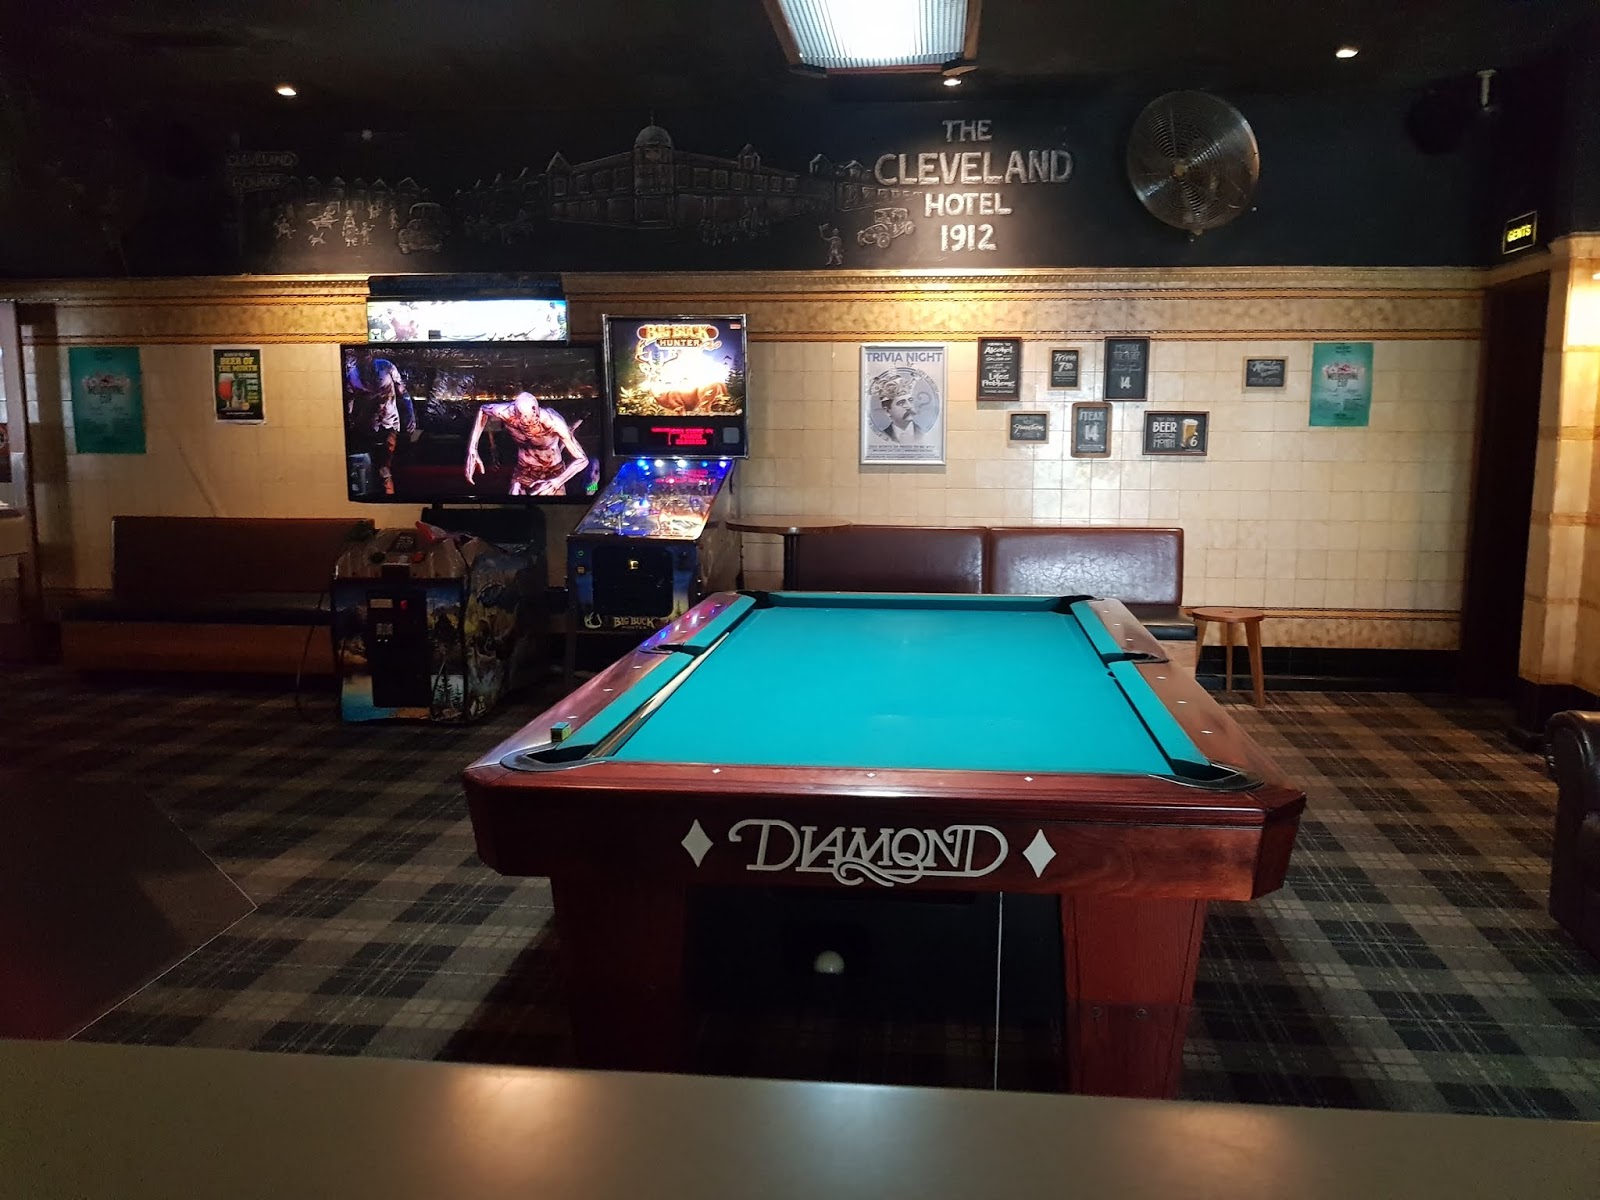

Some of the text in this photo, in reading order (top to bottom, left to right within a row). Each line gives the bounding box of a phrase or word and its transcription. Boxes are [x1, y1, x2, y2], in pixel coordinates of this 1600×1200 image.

[942, 119, 993, 143] THE
[874, 150, 1075, 186] CLEVELAND
[923, 192, 1013, 218] HOTEL
[940, 223, 997, 252] 1912
[660, 339, 700, 347] HUNTER
[867, 352, 943, 363] TRIVIA NIGHT
[1152, 421, 1178, 433] BEER
[728, 819, 1009, 886] DIAMOND
